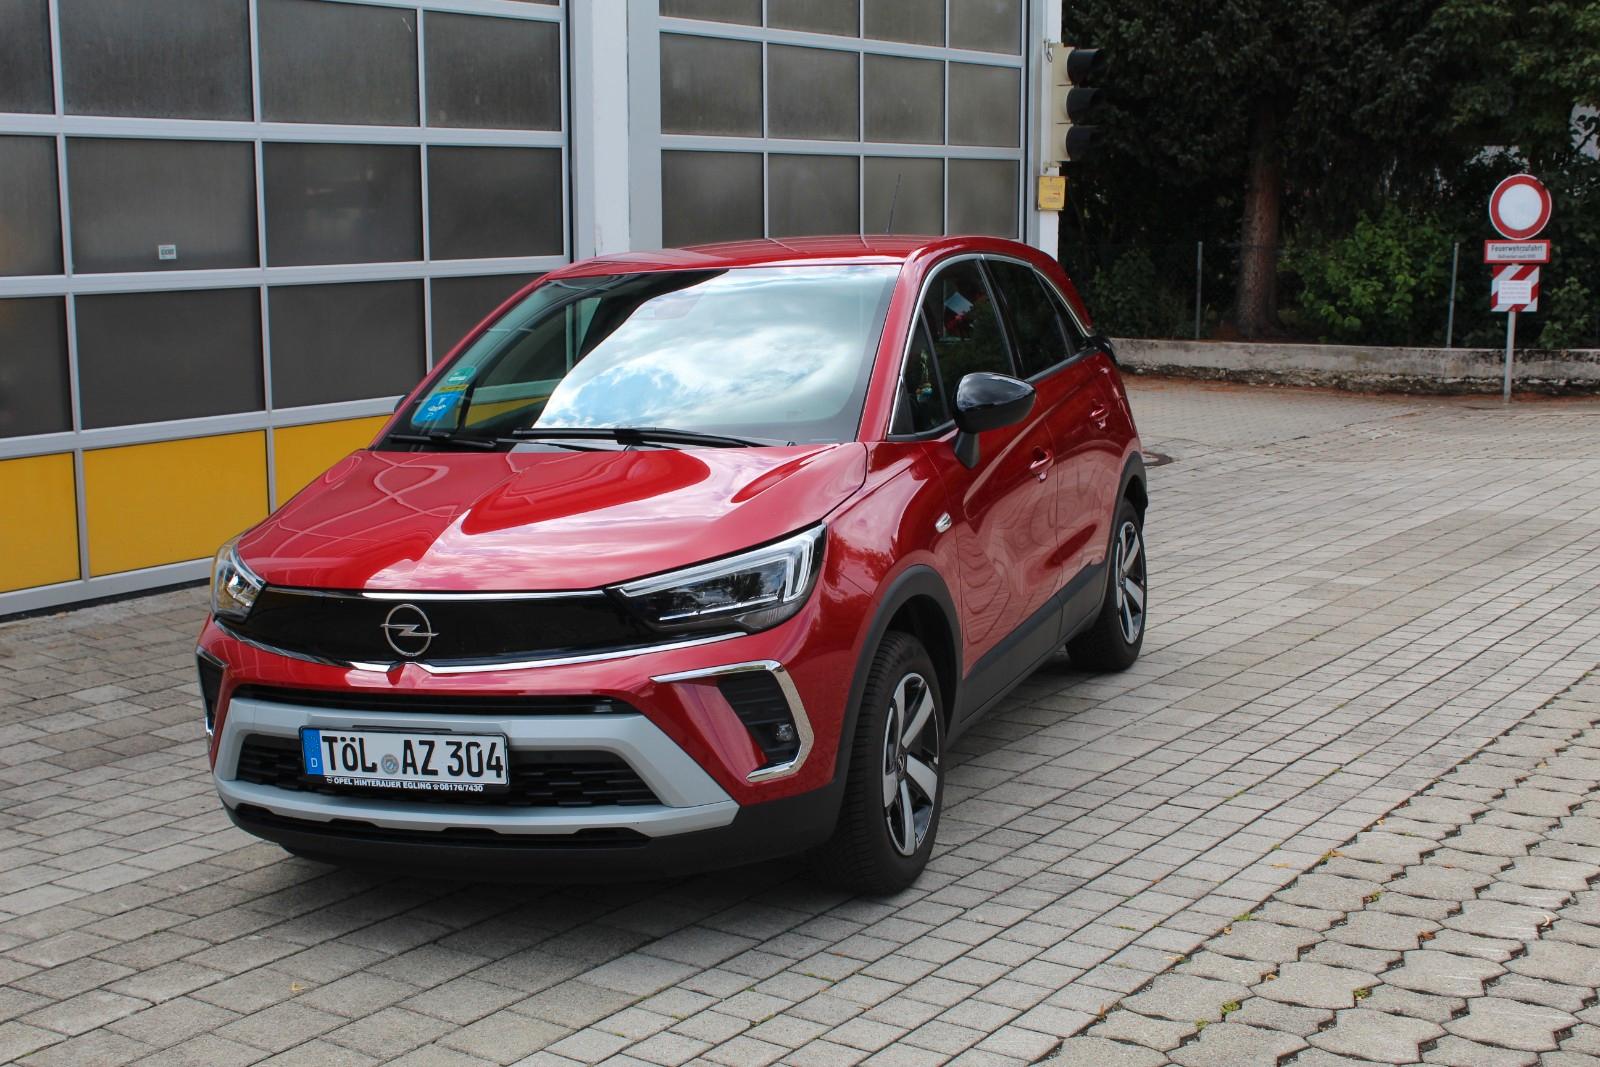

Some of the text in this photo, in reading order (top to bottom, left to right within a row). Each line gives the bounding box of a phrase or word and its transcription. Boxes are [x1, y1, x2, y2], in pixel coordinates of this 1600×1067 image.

[310, 757, 318, 768] D
[322, 735, 504, 778] TÖL AZ 304
[334, 777, 353, 785] OPEL
[354, 778, 401, 789] HINTERAUER
[403, 781, 432, 790] EGLING
